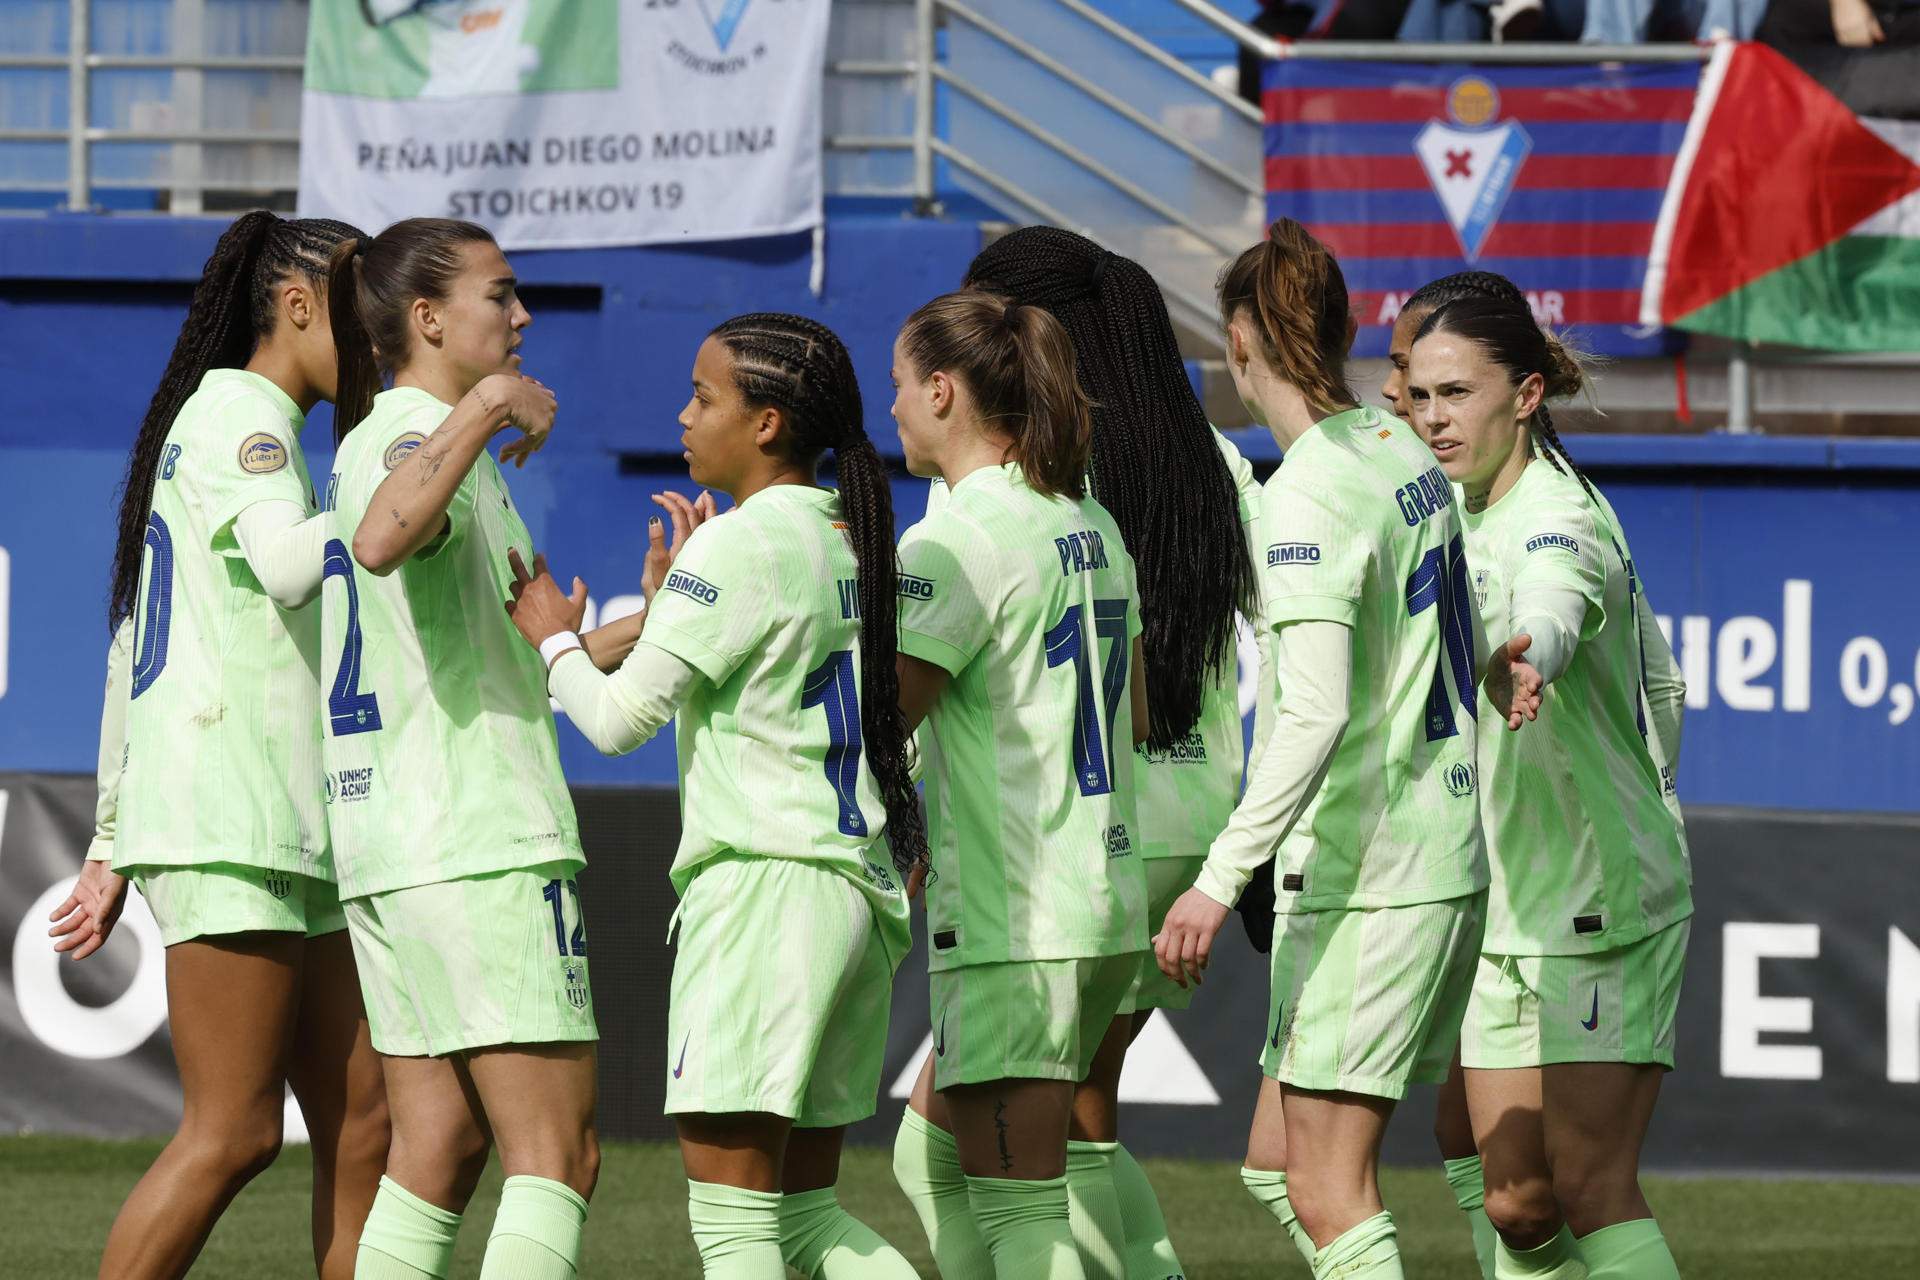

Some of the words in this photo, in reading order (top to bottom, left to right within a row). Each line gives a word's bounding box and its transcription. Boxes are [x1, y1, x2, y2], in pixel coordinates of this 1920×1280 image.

[357, 137, 438, 173] PEÑA
[443, 138, 532, 177] JUAN
[545, 133, 642, 166] DIEGO
[651, 124, 775, 160] MOLINA
[449, 183, 640, 219] STOICHKOV
[650, 180, 685, 210] 19
[1267, 546, 1321, 565] BIMBO
[1526, 535, 1580, 553] BIMBO
[667, 573, 719, 604] BIMBO
[1044, 598, 1130, 798] 17
[800, 650, 869, 838] 1
[543, 878, 588, 958] 12
